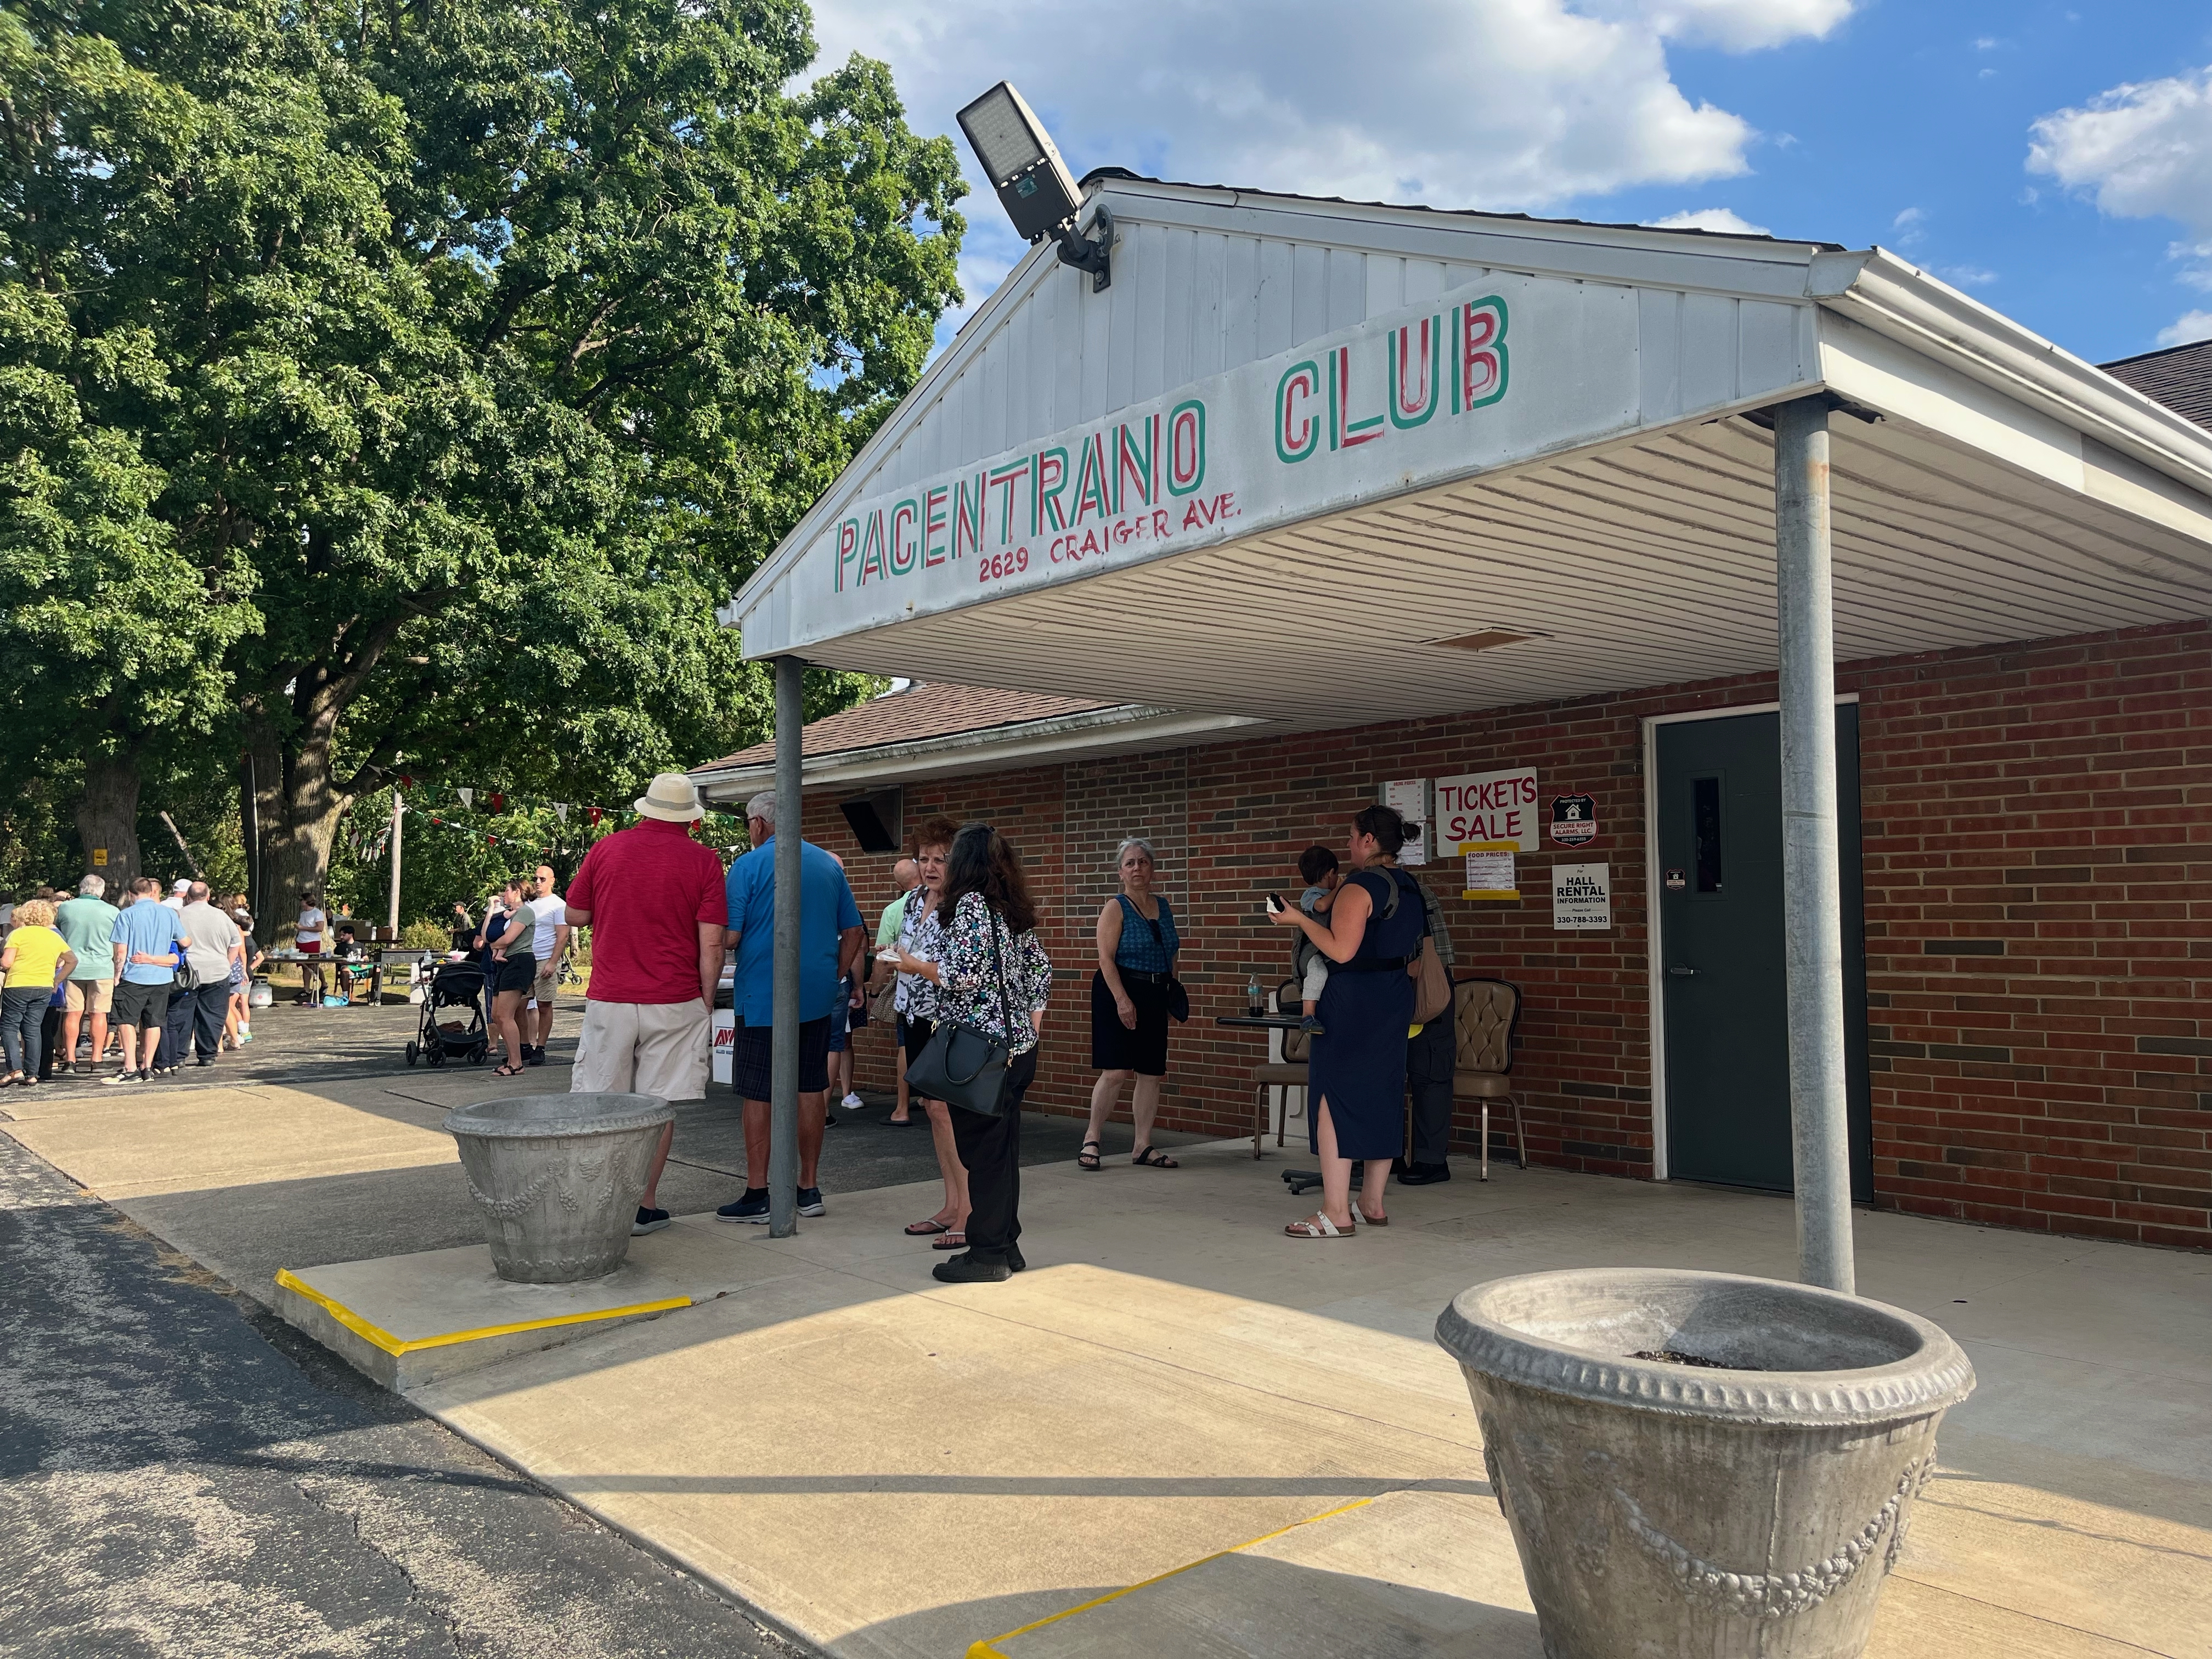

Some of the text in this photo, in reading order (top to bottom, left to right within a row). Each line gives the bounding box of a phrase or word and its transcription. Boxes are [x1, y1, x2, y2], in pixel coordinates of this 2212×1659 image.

[835, 295, 1509, 593] PACENTRANO CLUB
[980, 490, 1242, 583] 2629 CRAIGER AVE.
[1439, 776, 1537, 811] TICKETS
[1445, 810, 1523, 842] SALE
[1557, 885, 1605, 897] RENTAL
[1566, 876, 1595, 886] HALL
